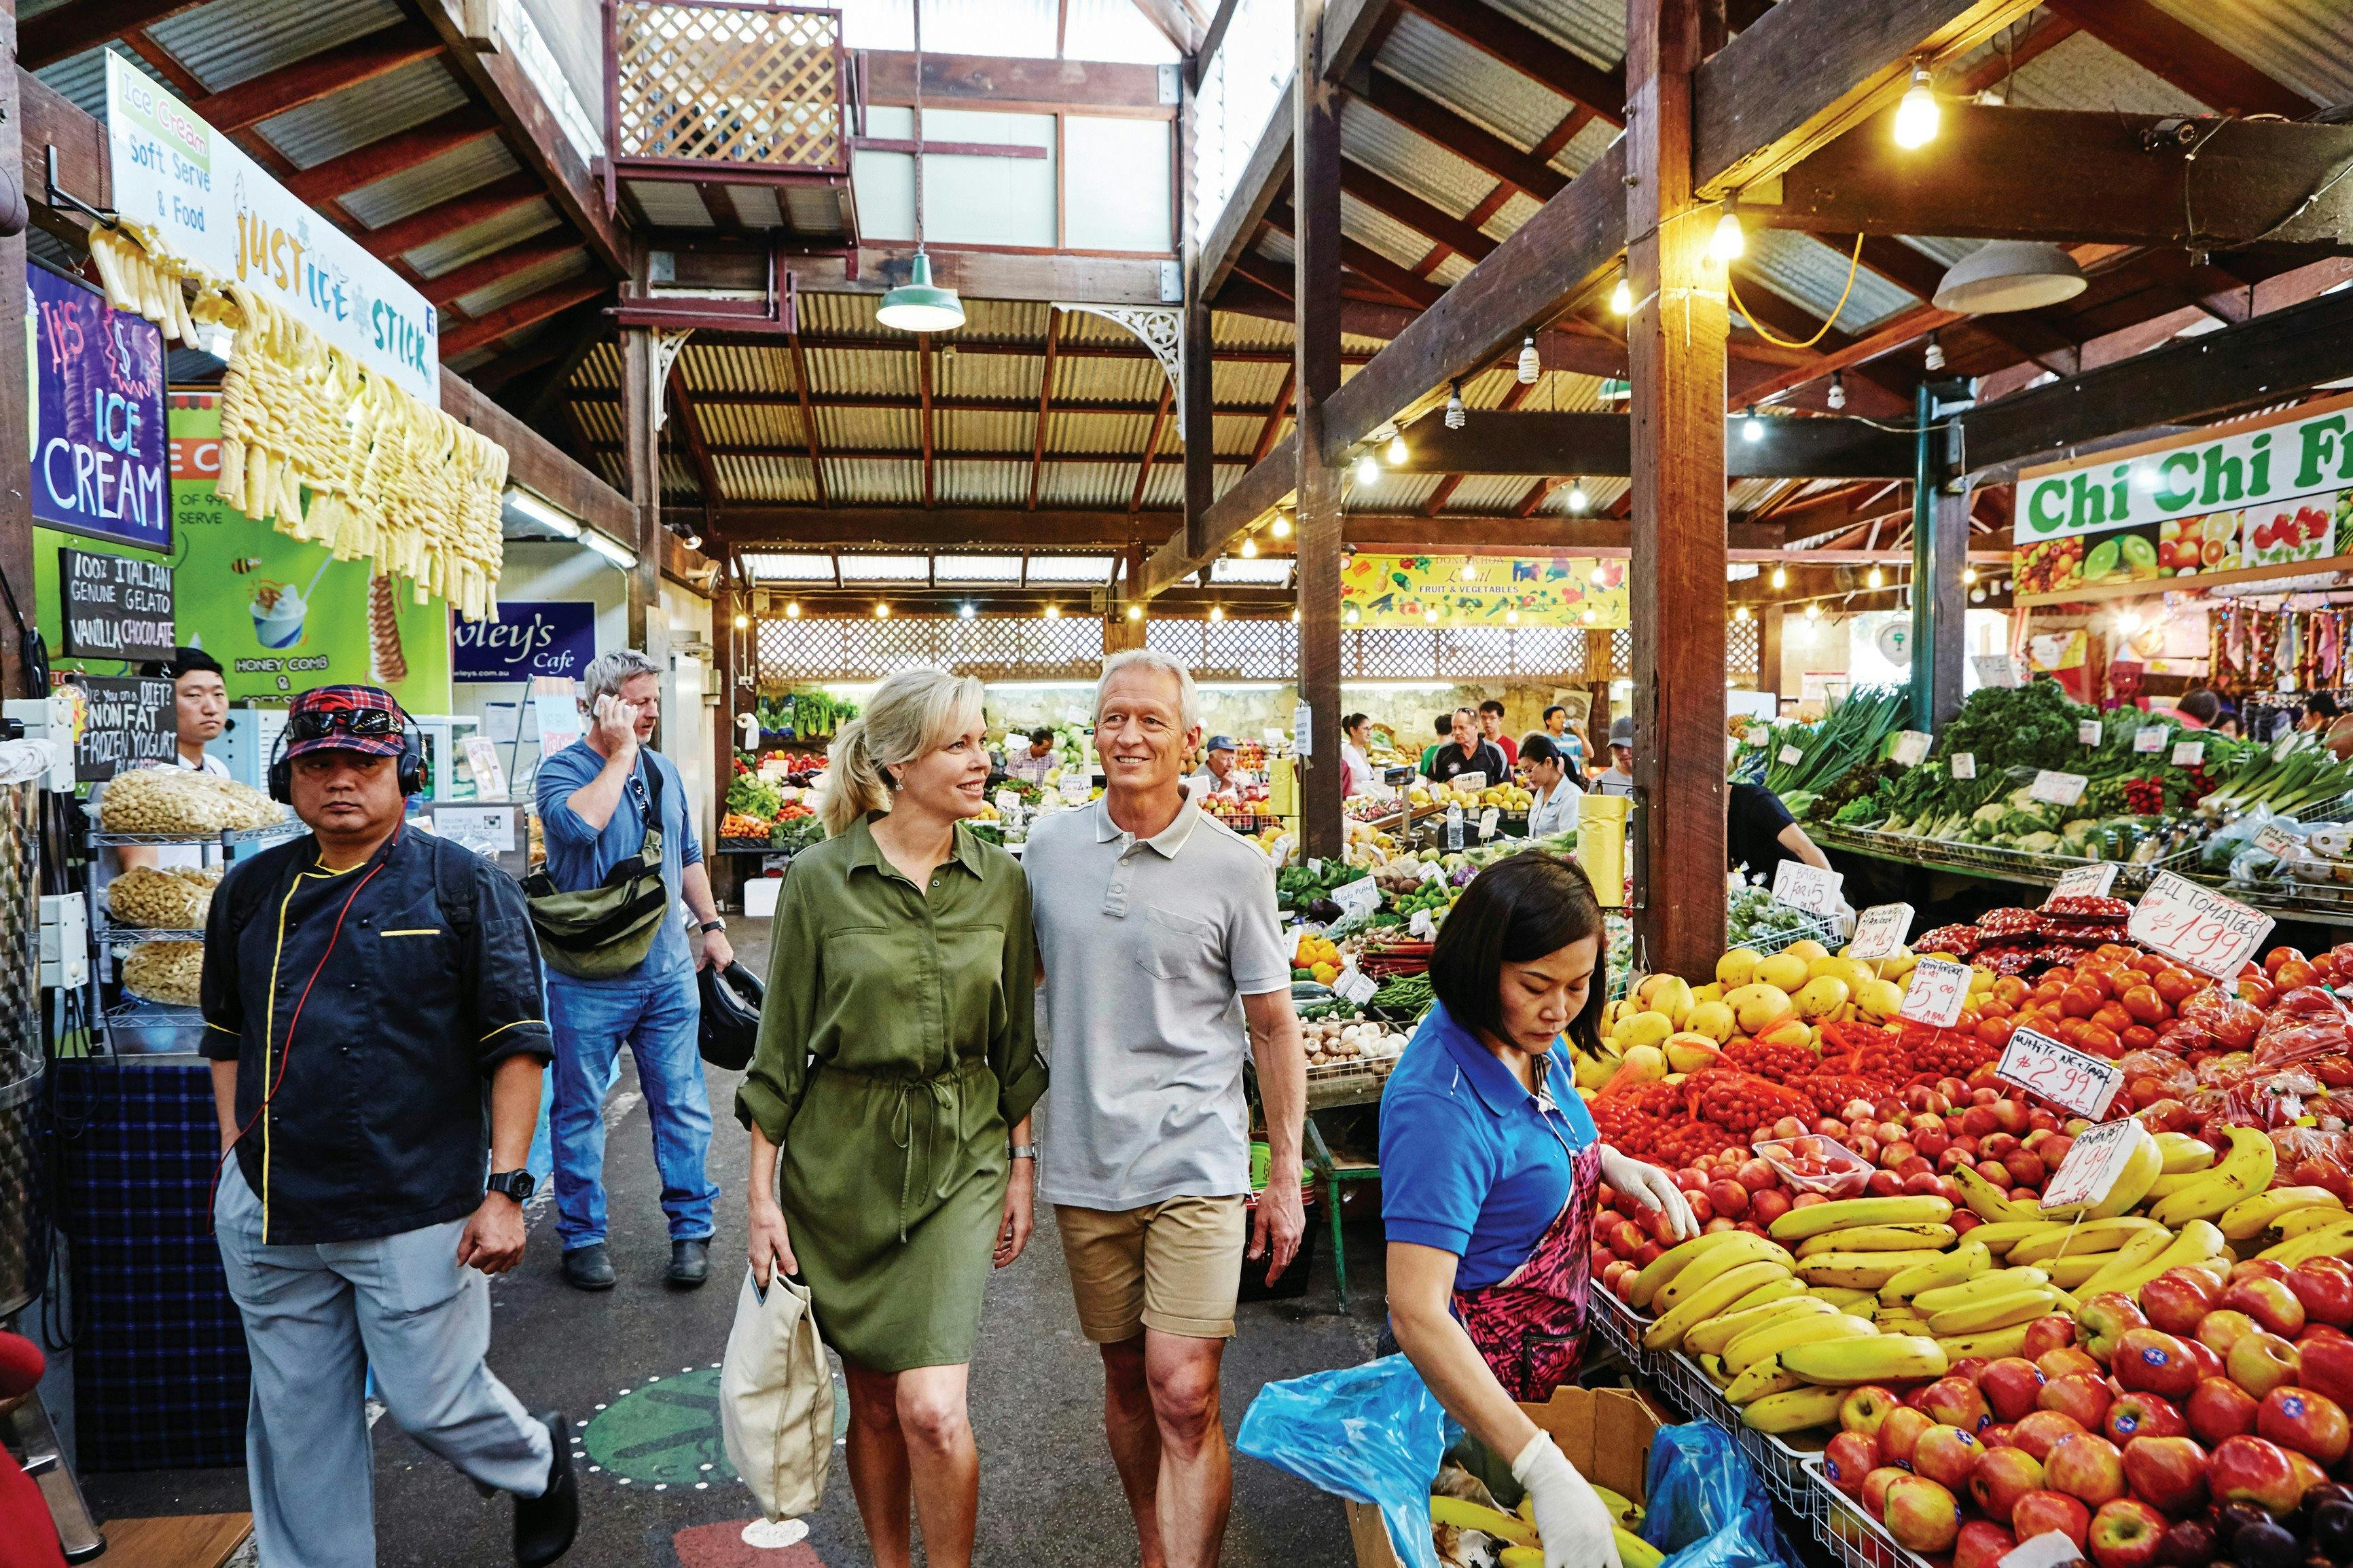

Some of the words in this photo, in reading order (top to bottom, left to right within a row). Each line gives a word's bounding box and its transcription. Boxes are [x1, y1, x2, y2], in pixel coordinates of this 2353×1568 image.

[123, 72, 151, 115] Ice
[158, 101, 206, 155] Cream
[130, 133, 166, 175] Soft
[173, 151, 211, 193] Serve
[157, 189, 166, 217] &
[173, 195, 205, 233] Food
[113, 319, 131, 381] $
[372, 298, 428, 378] STICK
[95, 387, 141, 458] ICE
[44, 437, 163, 530] CREAM
[2028, 464, 2130, 533] Chi
[2153, 432, 2271, 512] Chi
[180, 494, 201, 507] OF
[178, 511, 223, 525] SERVE
[114, 558, 171, 592] ITALIAN
[1419, 585, 1446, 594] FRUIT
[1450, 585, 1456, 594] &
[1459, 585, 1520, 594] VEGETABLES
[125, 588, 170, 614] GELATO
[121, 618, 175, 649] CHOCOLATE
[236, 657, 285, 672] HONEY
[287, 655, 328, 672] COMB
[533, 649, 575, 675] Cafe
[140, 680, 173, 708] DIET?
[276, 675, 290, 690] &
[89, 703, 122, 729] NON
[124, 703, 160, 732] FAT
[79, 729, 129, 766] FROZEN
[130, 729, 177, 761] YOGURT
[1776, 875, 1789, 902] 2
[1797, 868, 1822, 882] BAGS
[2149, 877, 2183, 900] ALL
